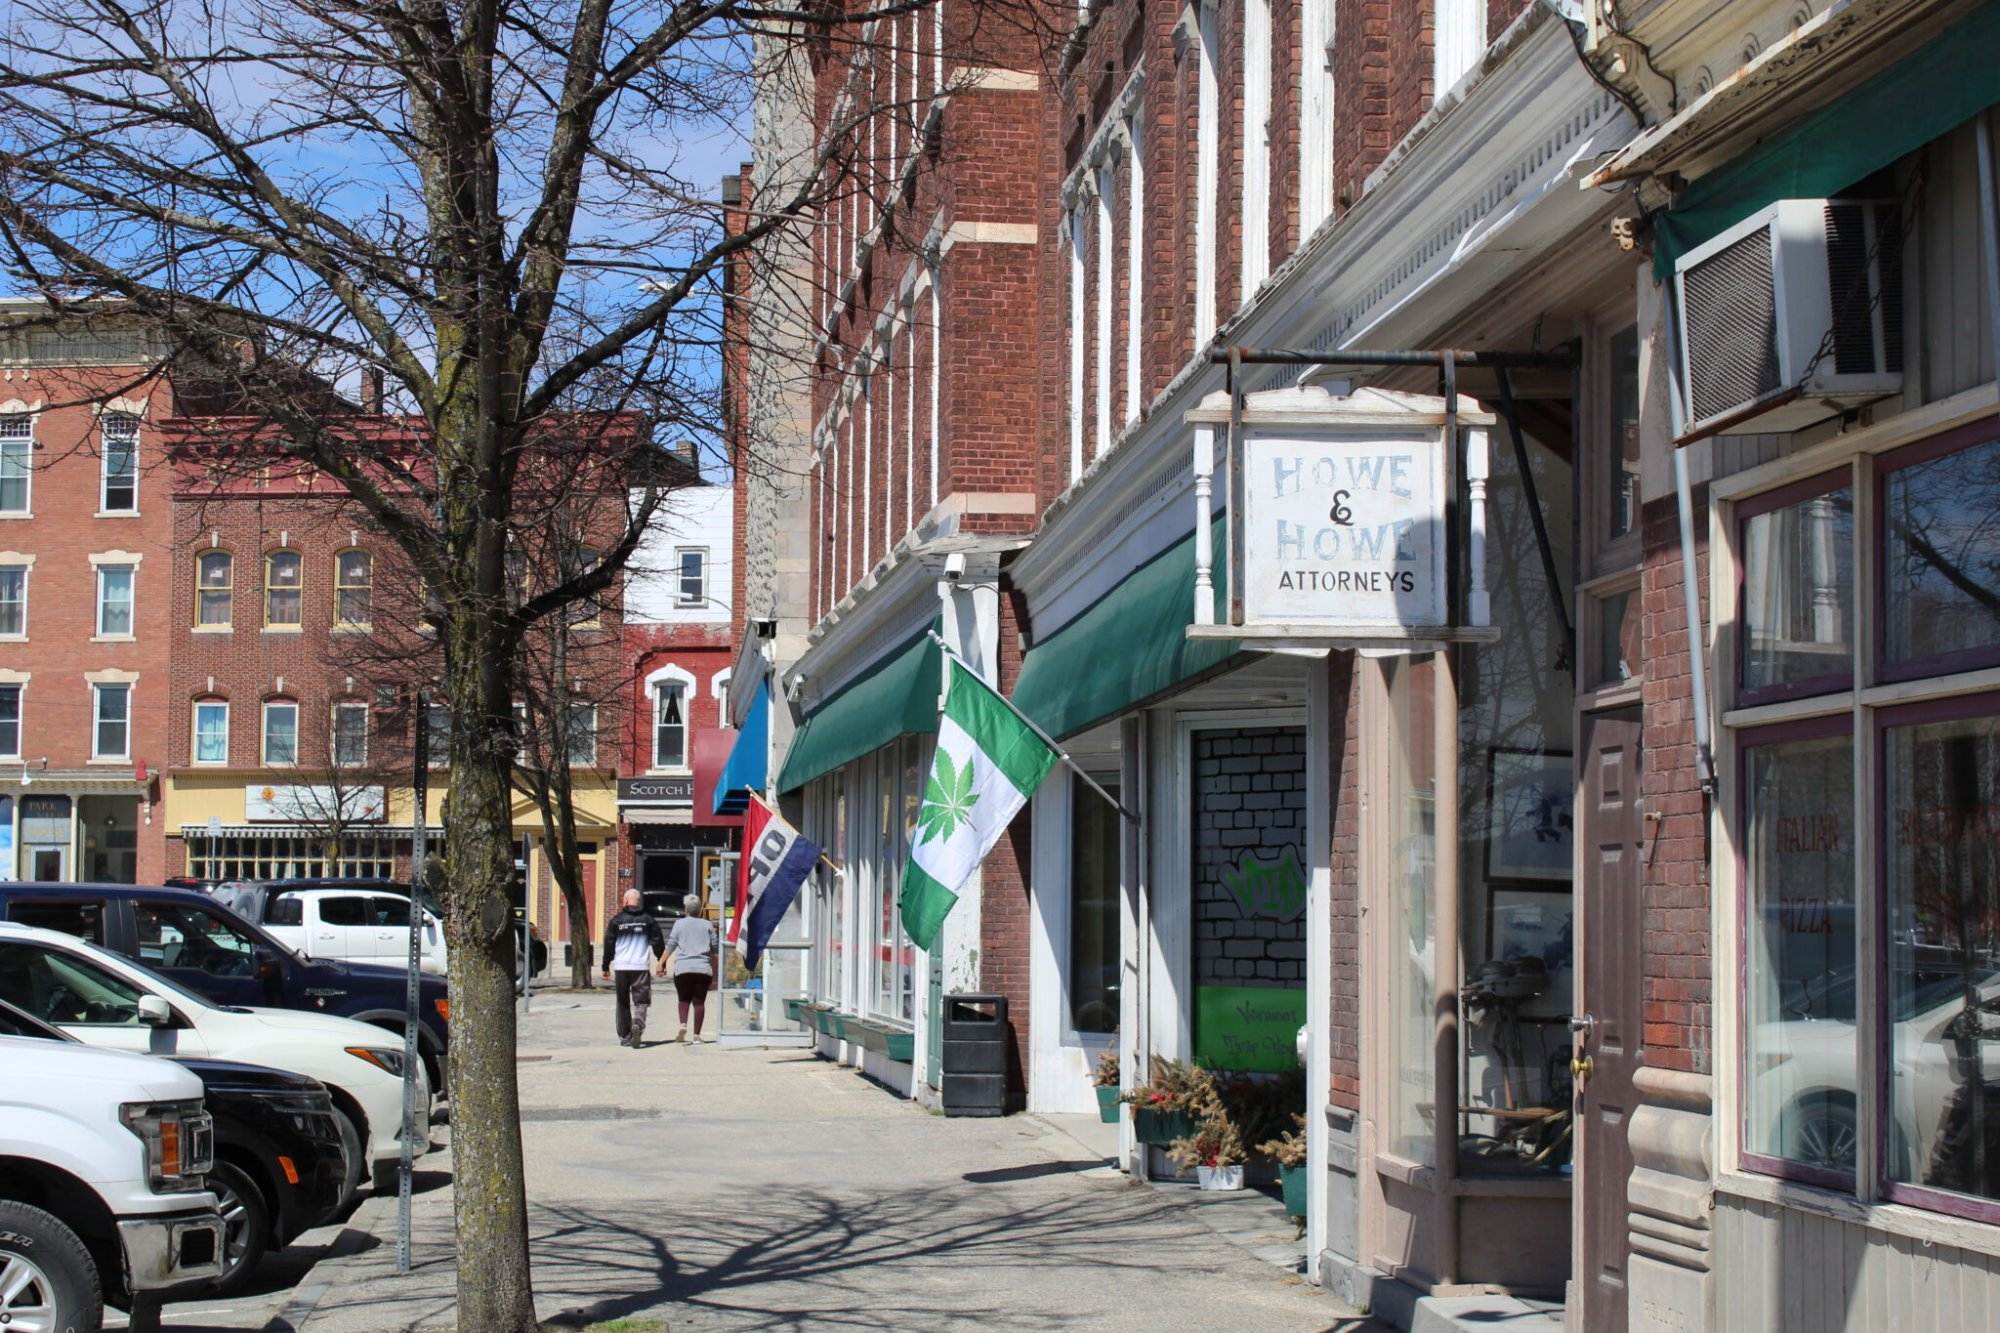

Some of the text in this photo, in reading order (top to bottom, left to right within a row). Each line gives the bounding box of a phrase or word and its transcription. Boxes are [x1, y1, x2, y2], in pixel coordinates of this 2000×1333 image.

[1271, 455, 1413, 500] HOWE
[1329, 489, 1354, 526] &
[1275, 517, 1417, 562] HOWE
[1278, 570, 1415, 593] ATTORNEYS
[1780, 896, 1834, 935] PIZZA
